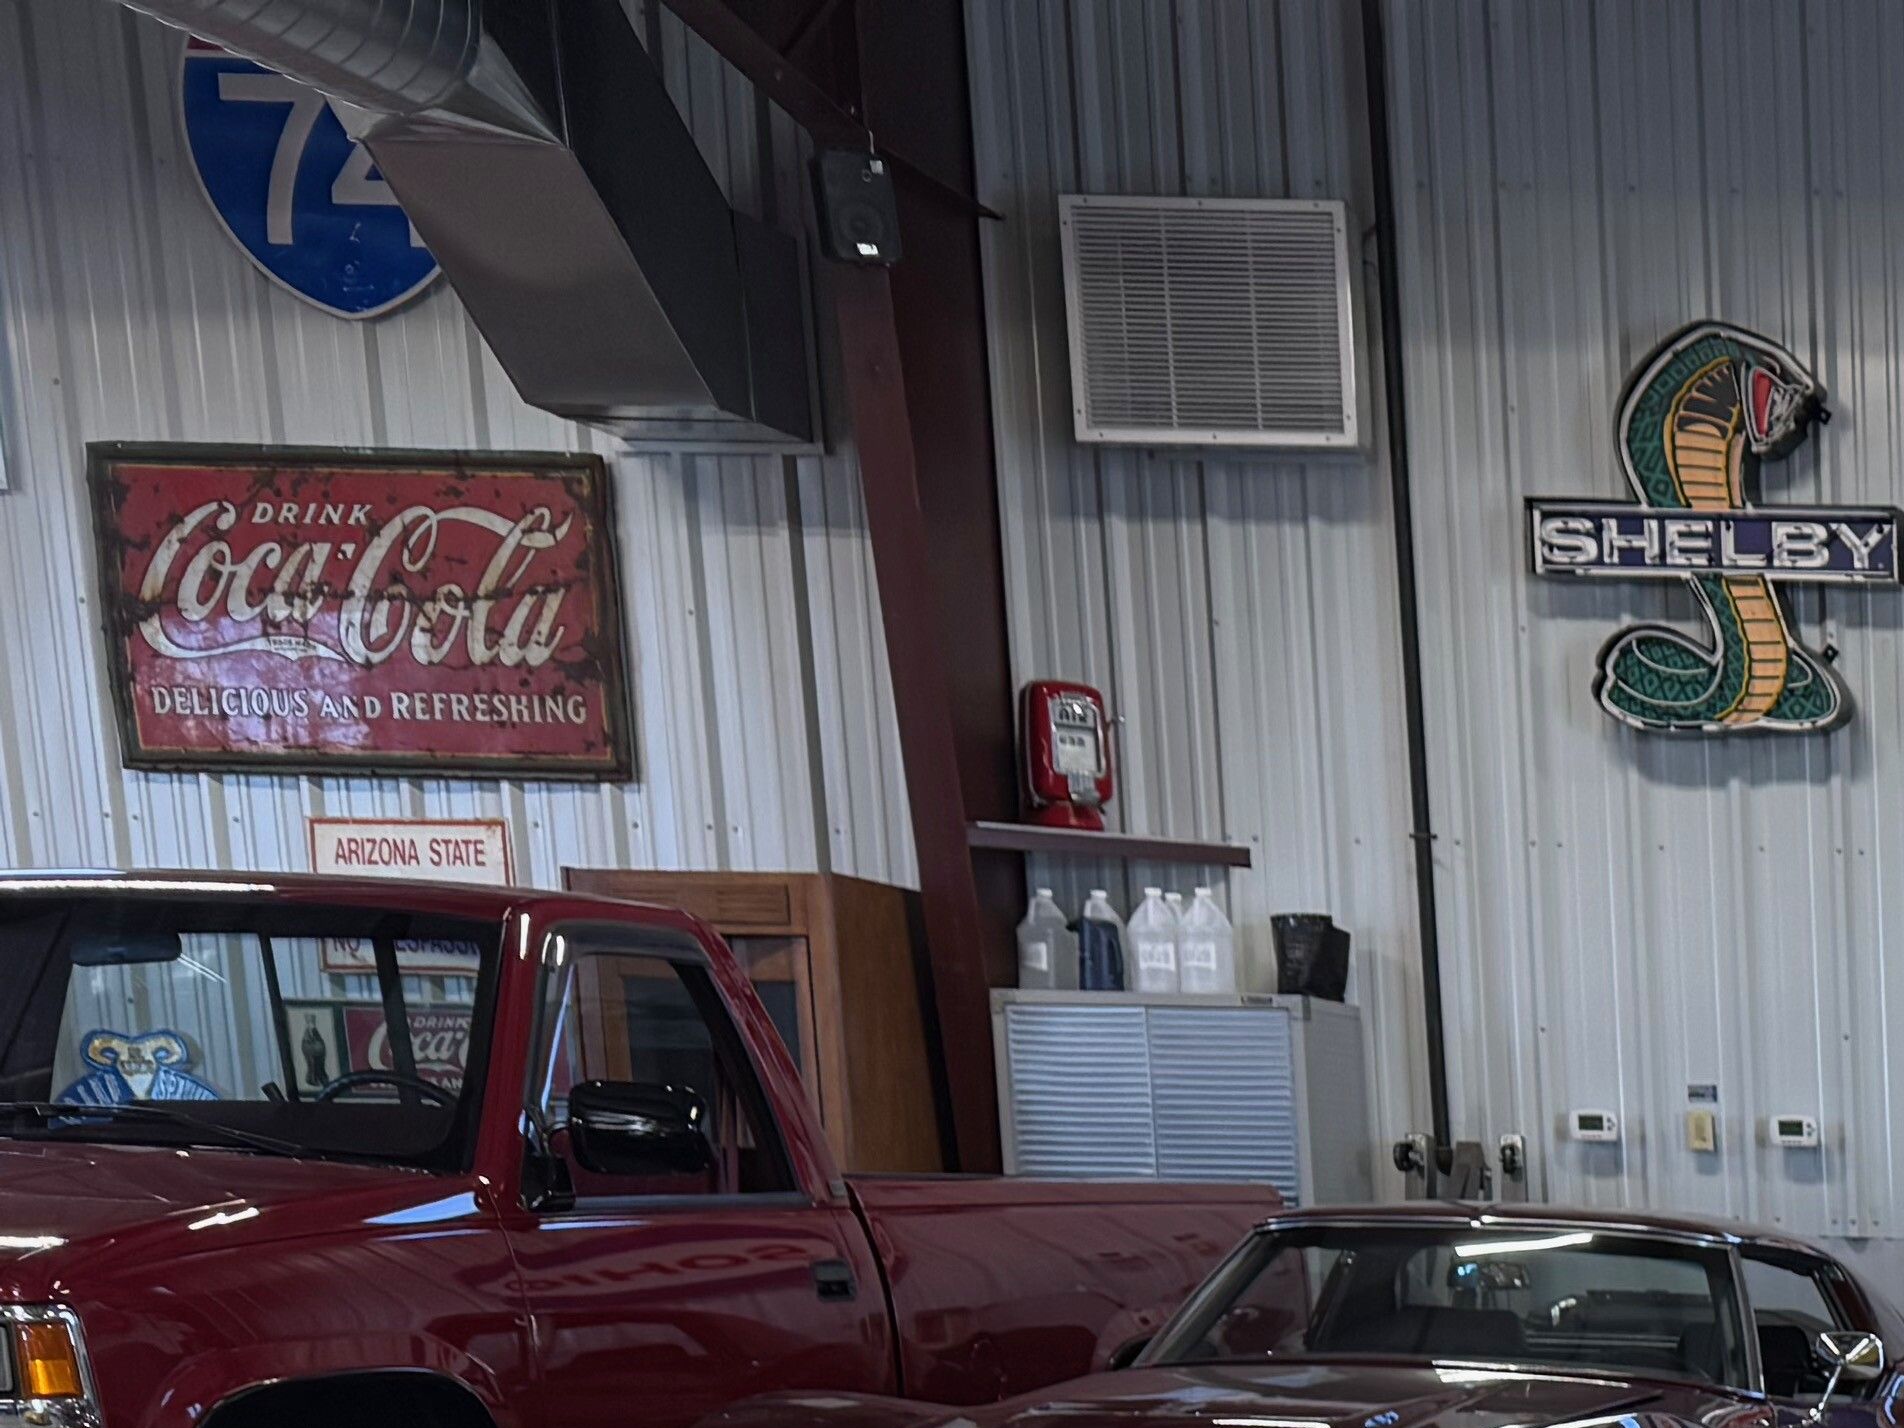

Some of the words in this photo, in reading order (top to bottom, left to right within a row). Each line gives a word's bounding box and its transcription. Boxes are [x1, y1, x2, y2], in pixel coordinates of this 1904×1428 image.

[250, 500, 376, 526] DRINK
[1541, 517, 1893, 570] SHELBY
[152, 686, 310, 717] DELICIOUS
[320, 696, 382, 720] AND
[391, 690, 588, 726] REFRESHING
[334, 836, 421, 867] ARIZONA
[428, 837, 487, 868] STATE
